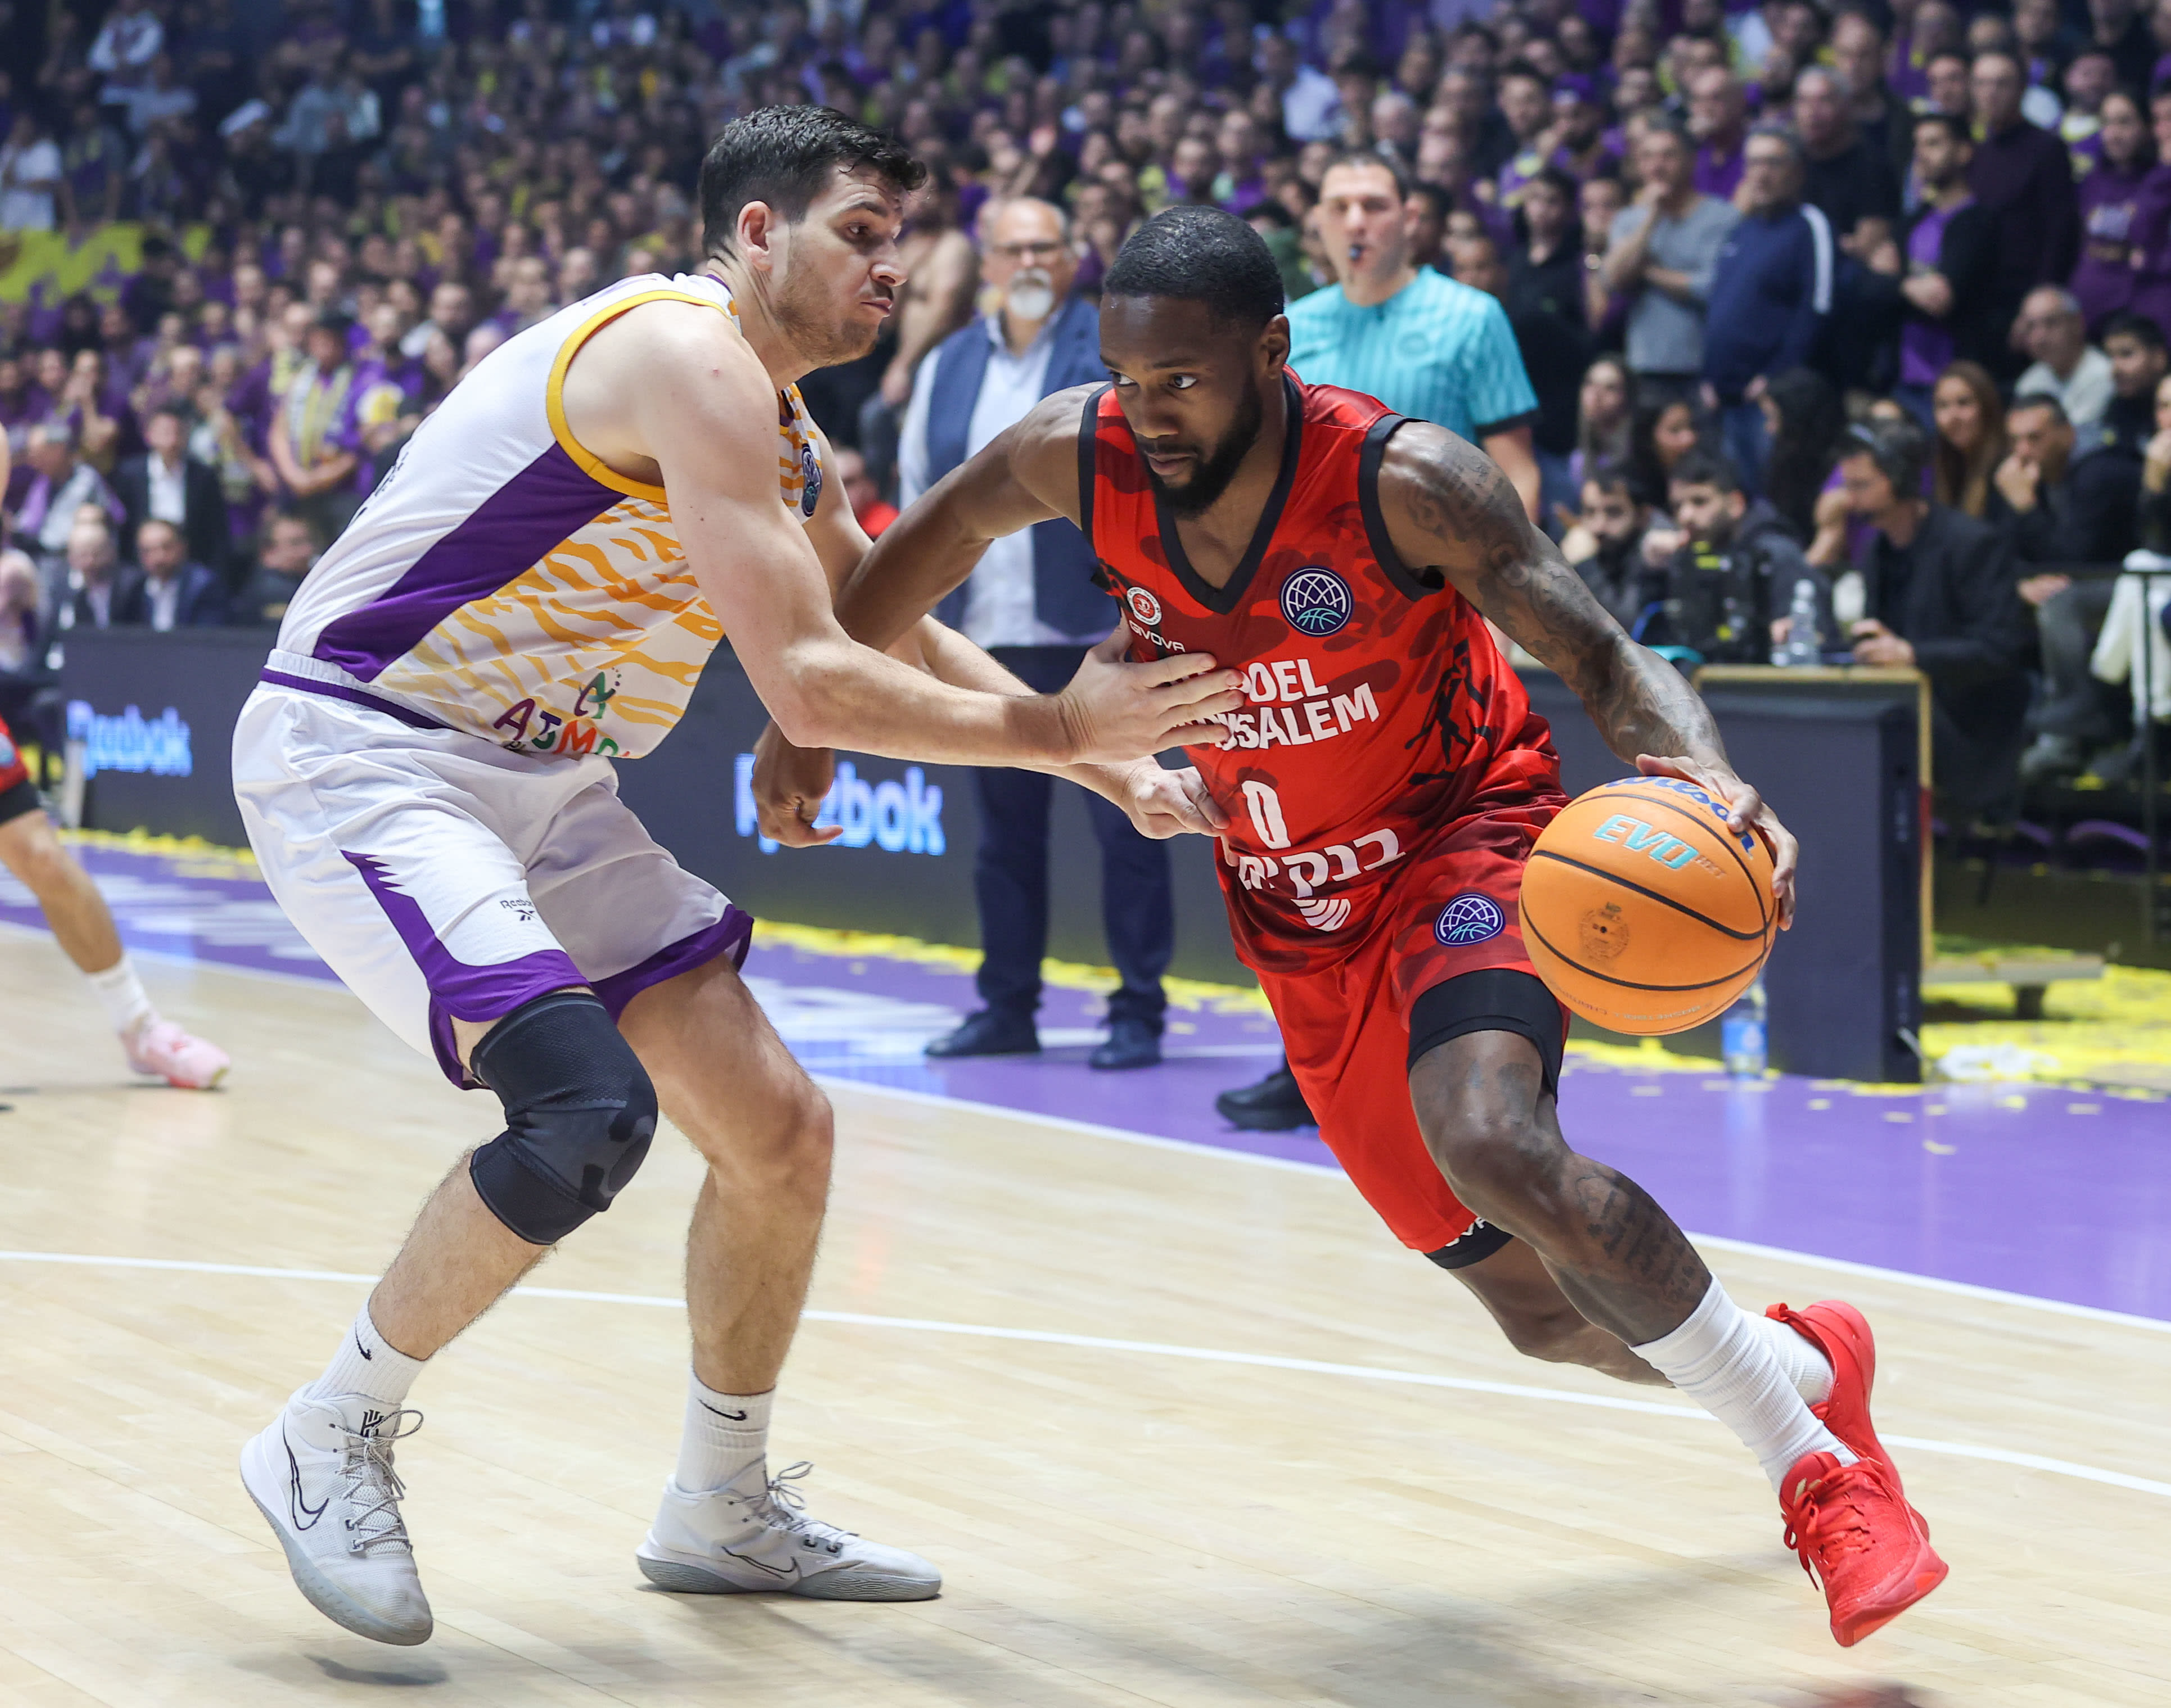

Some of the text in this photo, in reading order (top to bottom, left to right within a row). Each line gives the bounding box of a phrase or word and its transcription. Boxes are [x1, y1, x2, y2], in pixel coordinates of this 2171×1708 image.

[1129, 620, 1186, 653] GIVOVA
[1241, 780, 1291, 850] 0
[1593, 813, 1699, 871] EVO
[1281, 828, 1406, 899] בנק
